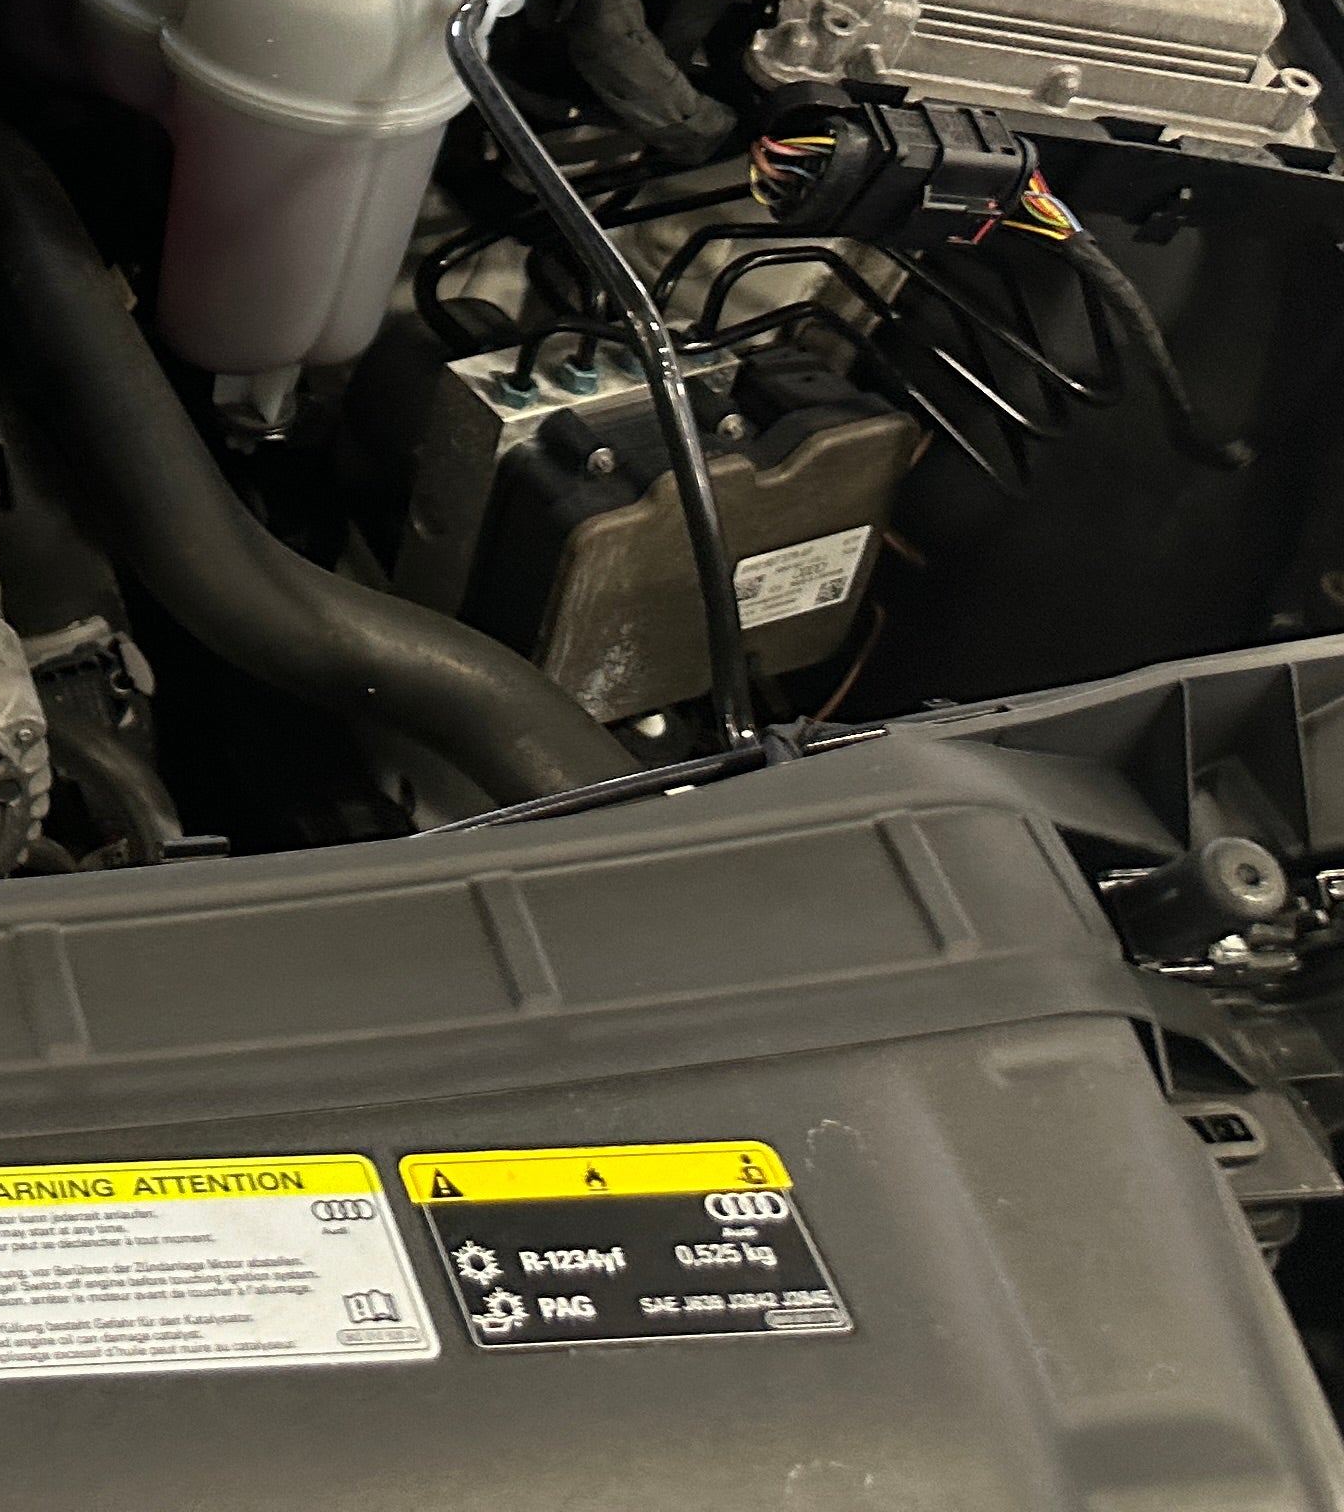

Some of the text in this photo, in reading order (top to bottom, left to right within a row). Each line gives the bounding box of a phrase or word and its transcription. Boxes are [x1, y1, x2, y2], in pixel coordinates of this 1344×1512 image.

[132, 1171, 304, 1196] ATTENTION
[518, 1246, 627, 1272] R-1234yf
[537, 1295, 597, 1318] PAG
[639, 1295, 682, 1312] SAE
